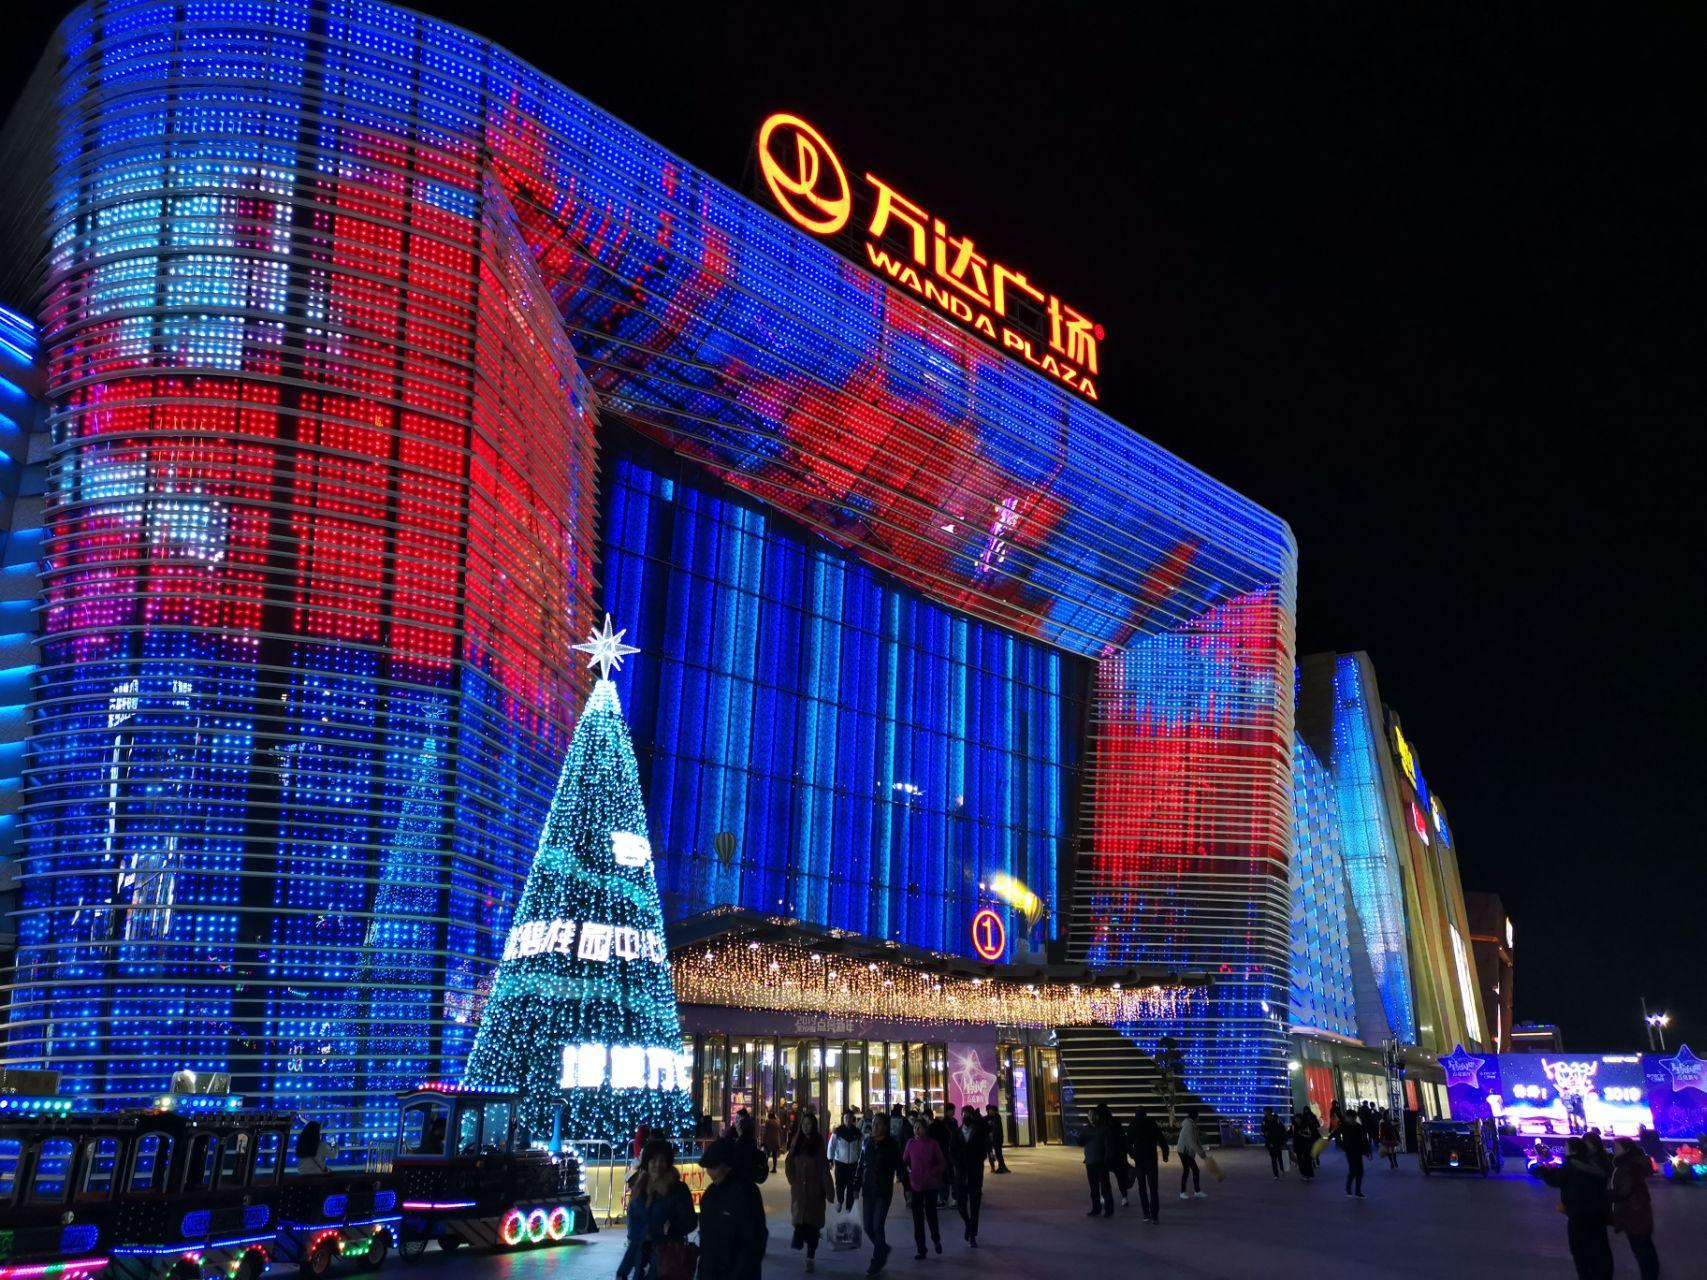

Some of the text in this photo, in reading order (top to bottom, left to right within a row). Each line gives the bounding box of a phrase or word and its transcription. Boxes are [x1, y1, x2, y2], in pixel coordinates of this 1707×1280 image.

[864, 171, 1099, 375] 万达广场
[865, 241, 1099, 401] WANDA PLAZA
